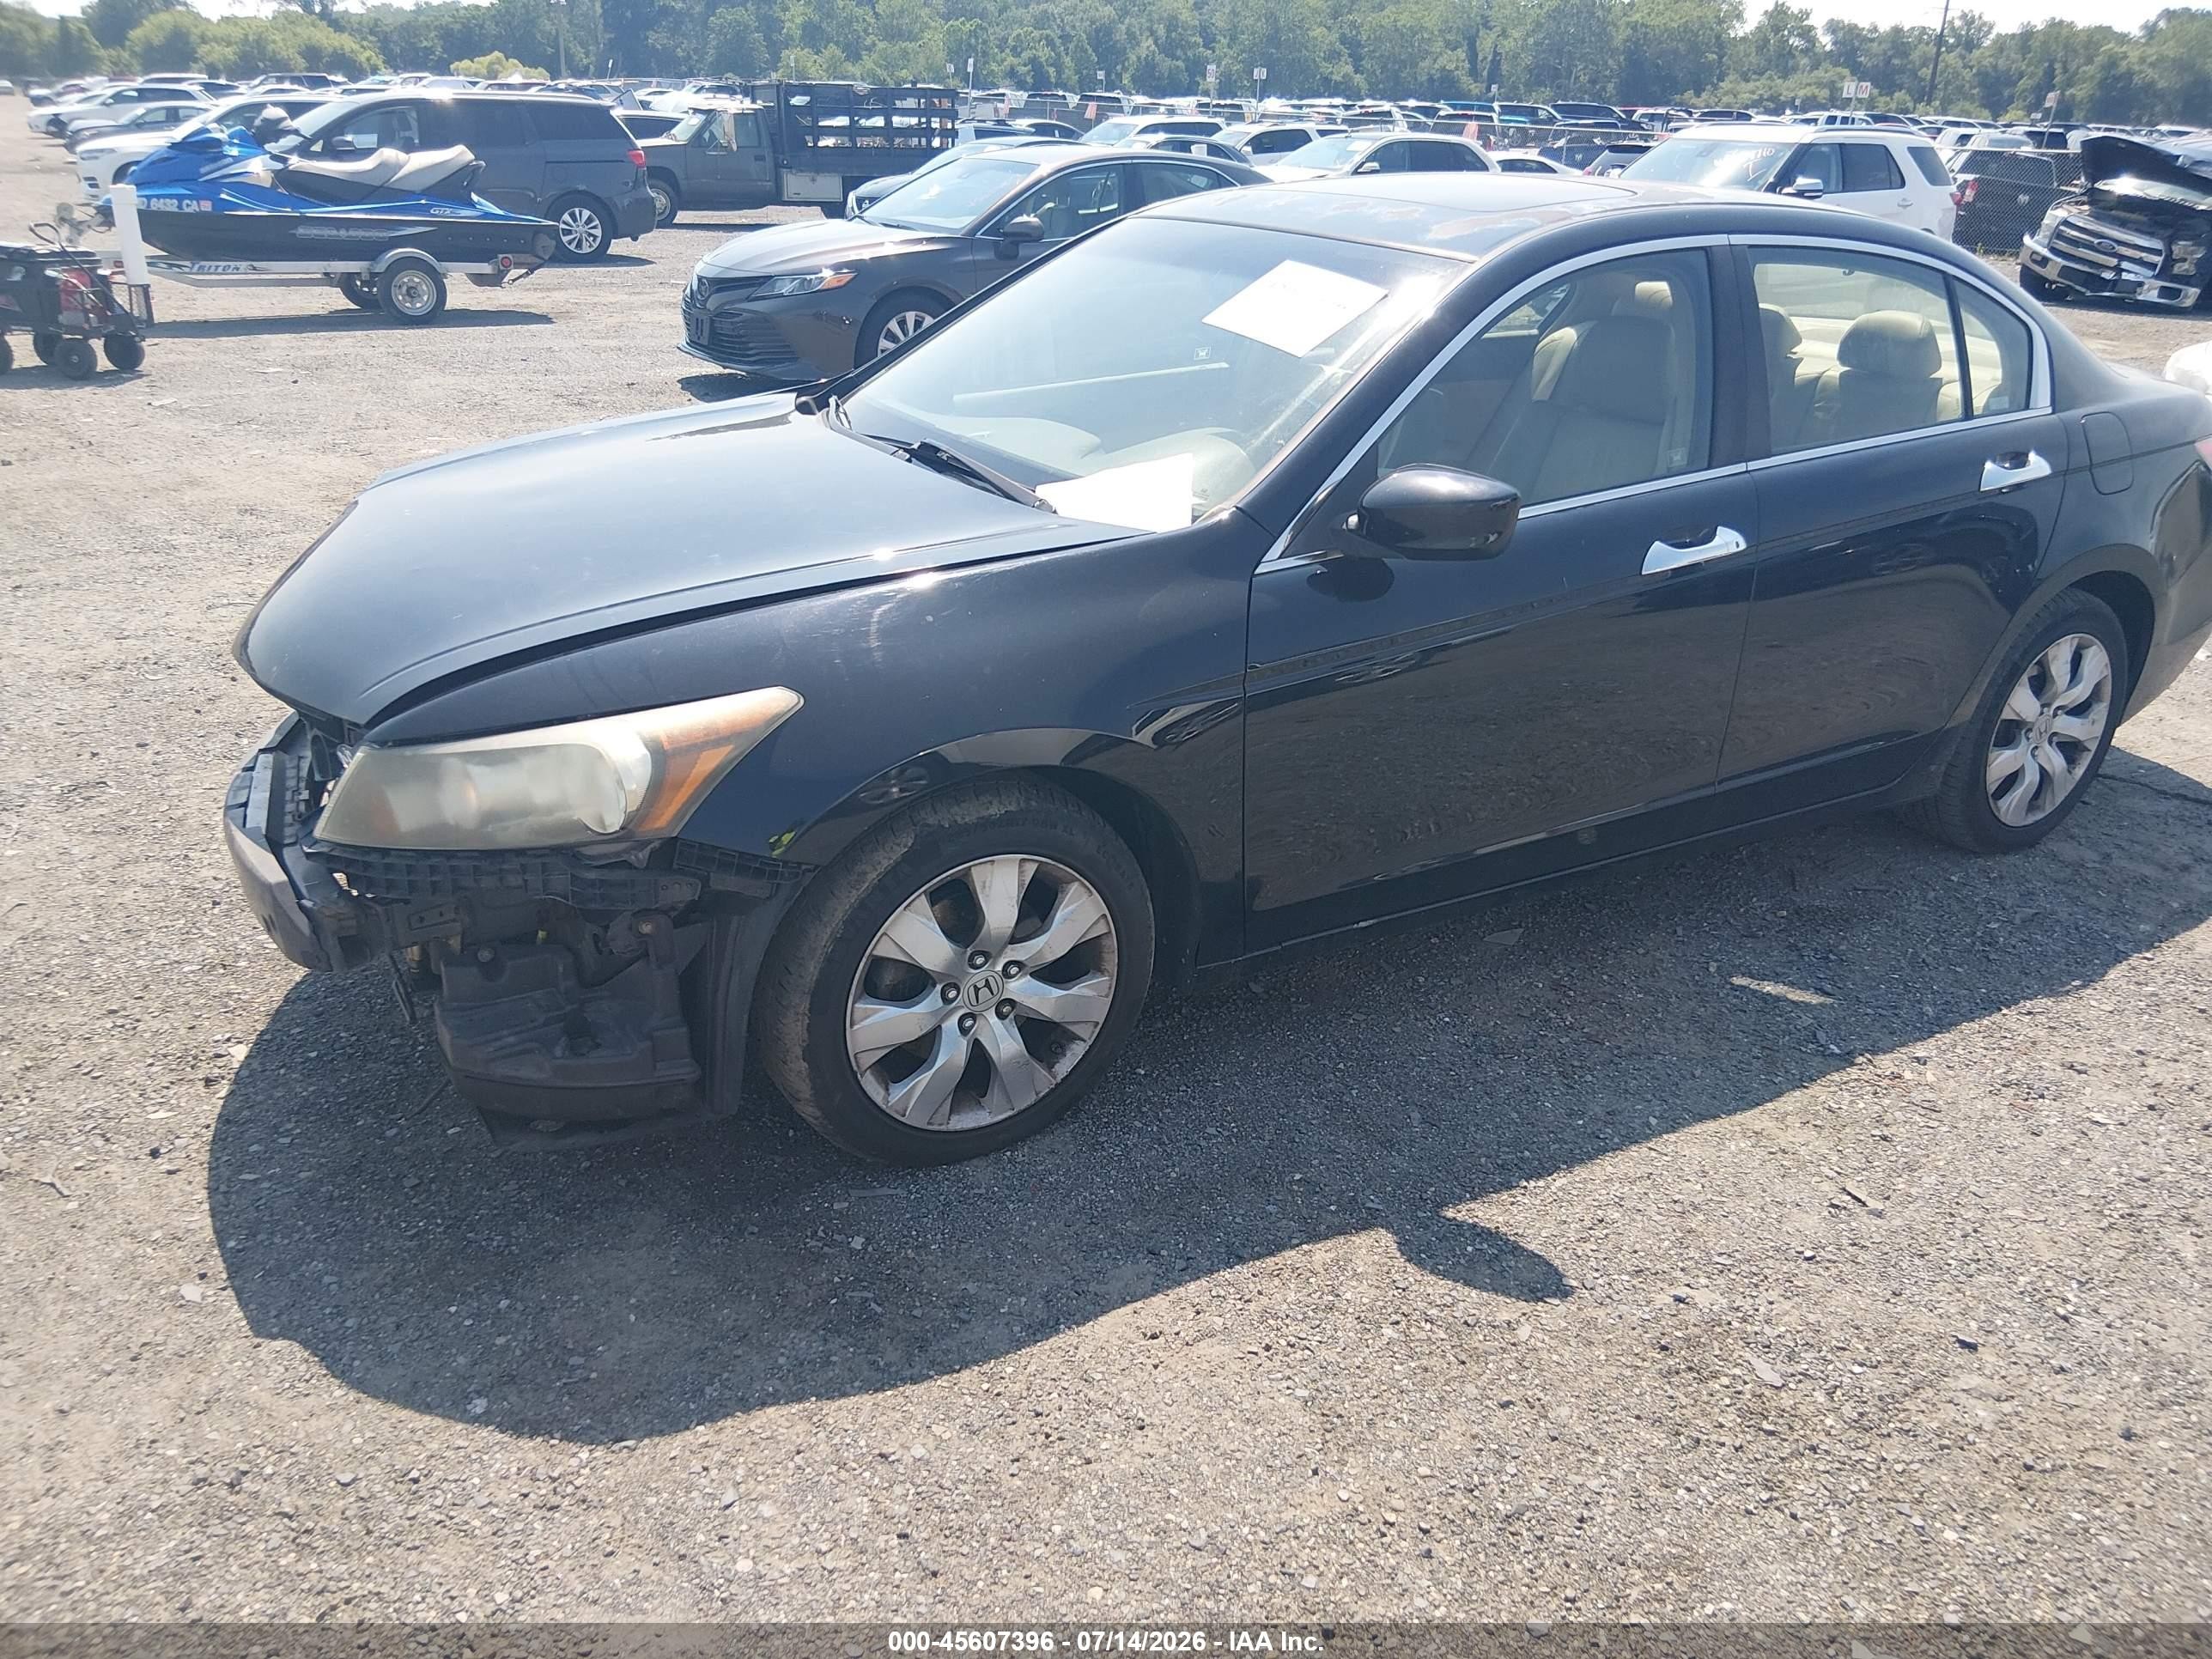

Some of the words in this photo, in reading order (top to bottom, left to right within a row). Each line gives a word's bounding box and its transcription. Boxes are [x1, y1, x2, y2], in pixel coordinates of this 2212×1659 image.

[1207, 69, 1215, 79] 50
[1846, 84, 1852, 95] L
[1858, 84, 1869, 95] M
[150, 198, 179, 212] 6432
[182, 199, 200, 213] CA
